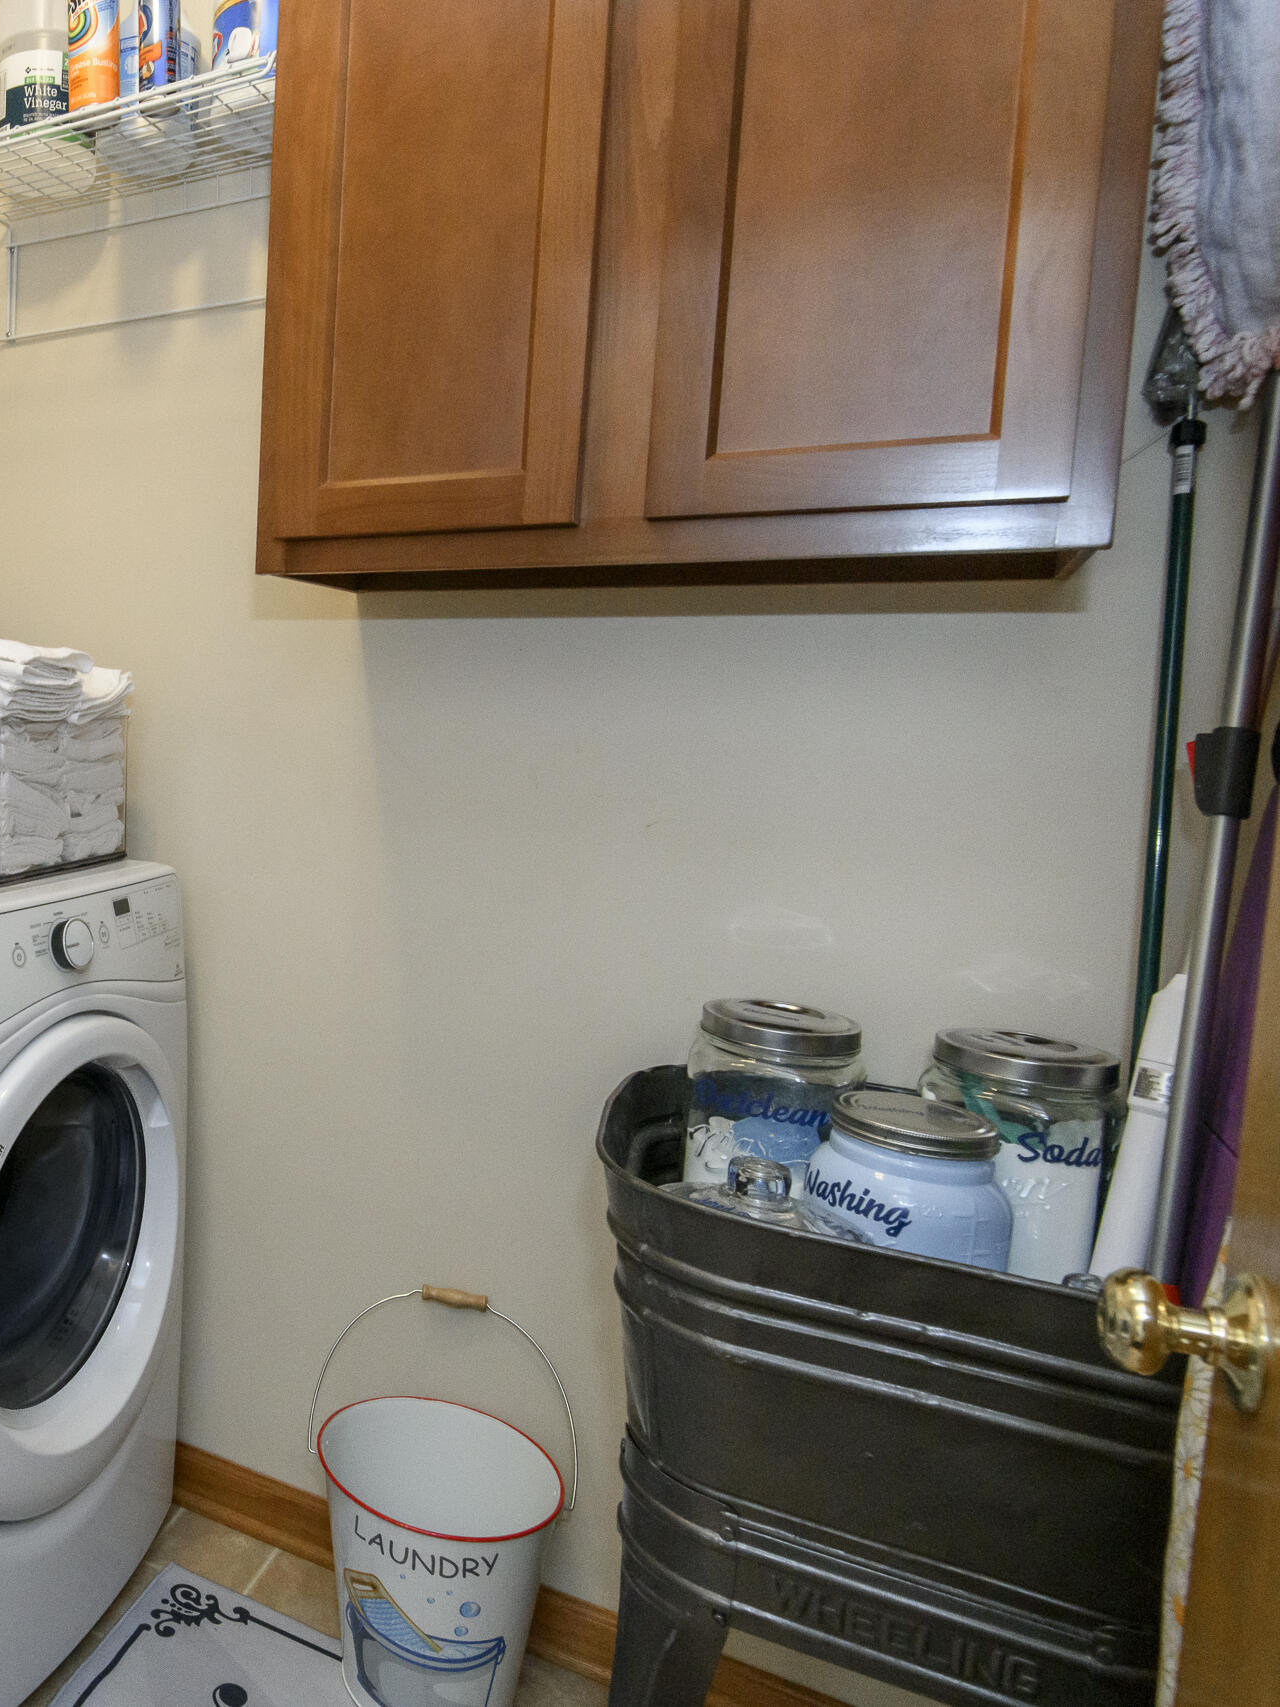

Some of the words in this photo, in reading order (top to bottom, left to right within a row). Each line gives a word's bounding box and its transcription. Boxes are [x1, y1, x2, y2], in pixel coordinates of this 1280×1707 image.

[24, 85, 57, 97] White
[24, 97, 67, 111] Vinegar
[1016, 1131, 1103, 1168] Soda
[803, 1162, 912, 1238] Washing
[353, 1514, 499, 1579] LAUNDRY
